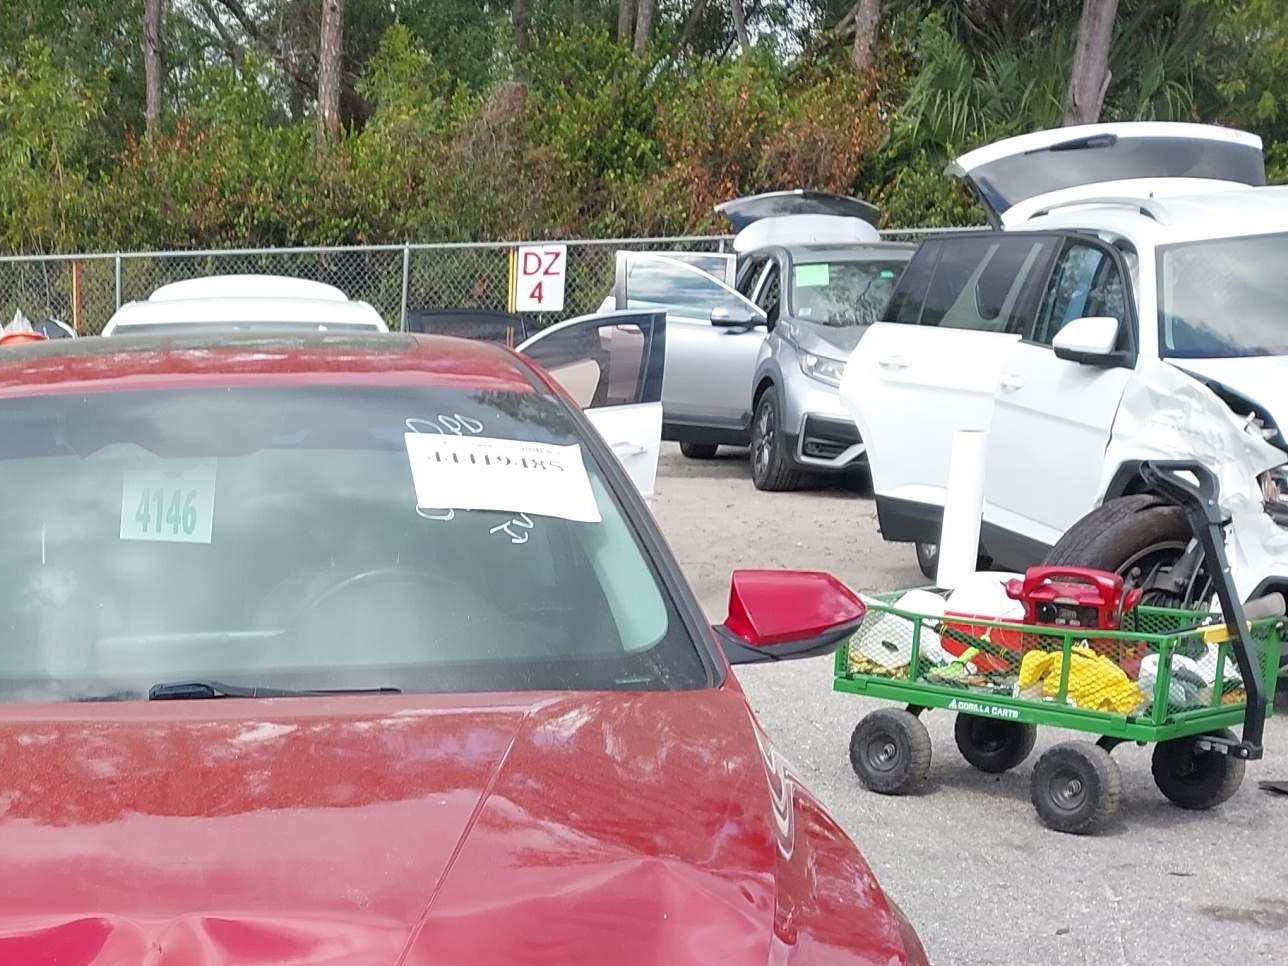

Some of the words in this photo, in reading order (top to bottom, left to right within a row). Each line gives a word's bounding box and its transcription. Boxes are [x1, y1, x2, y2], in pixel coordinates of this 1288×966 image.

[523, 251, 561, 275] DZ
[529, 281, 544, 304] 4
[136, 487, 197, 535] 4146
[958, 701, 990, 713] GORILLA
